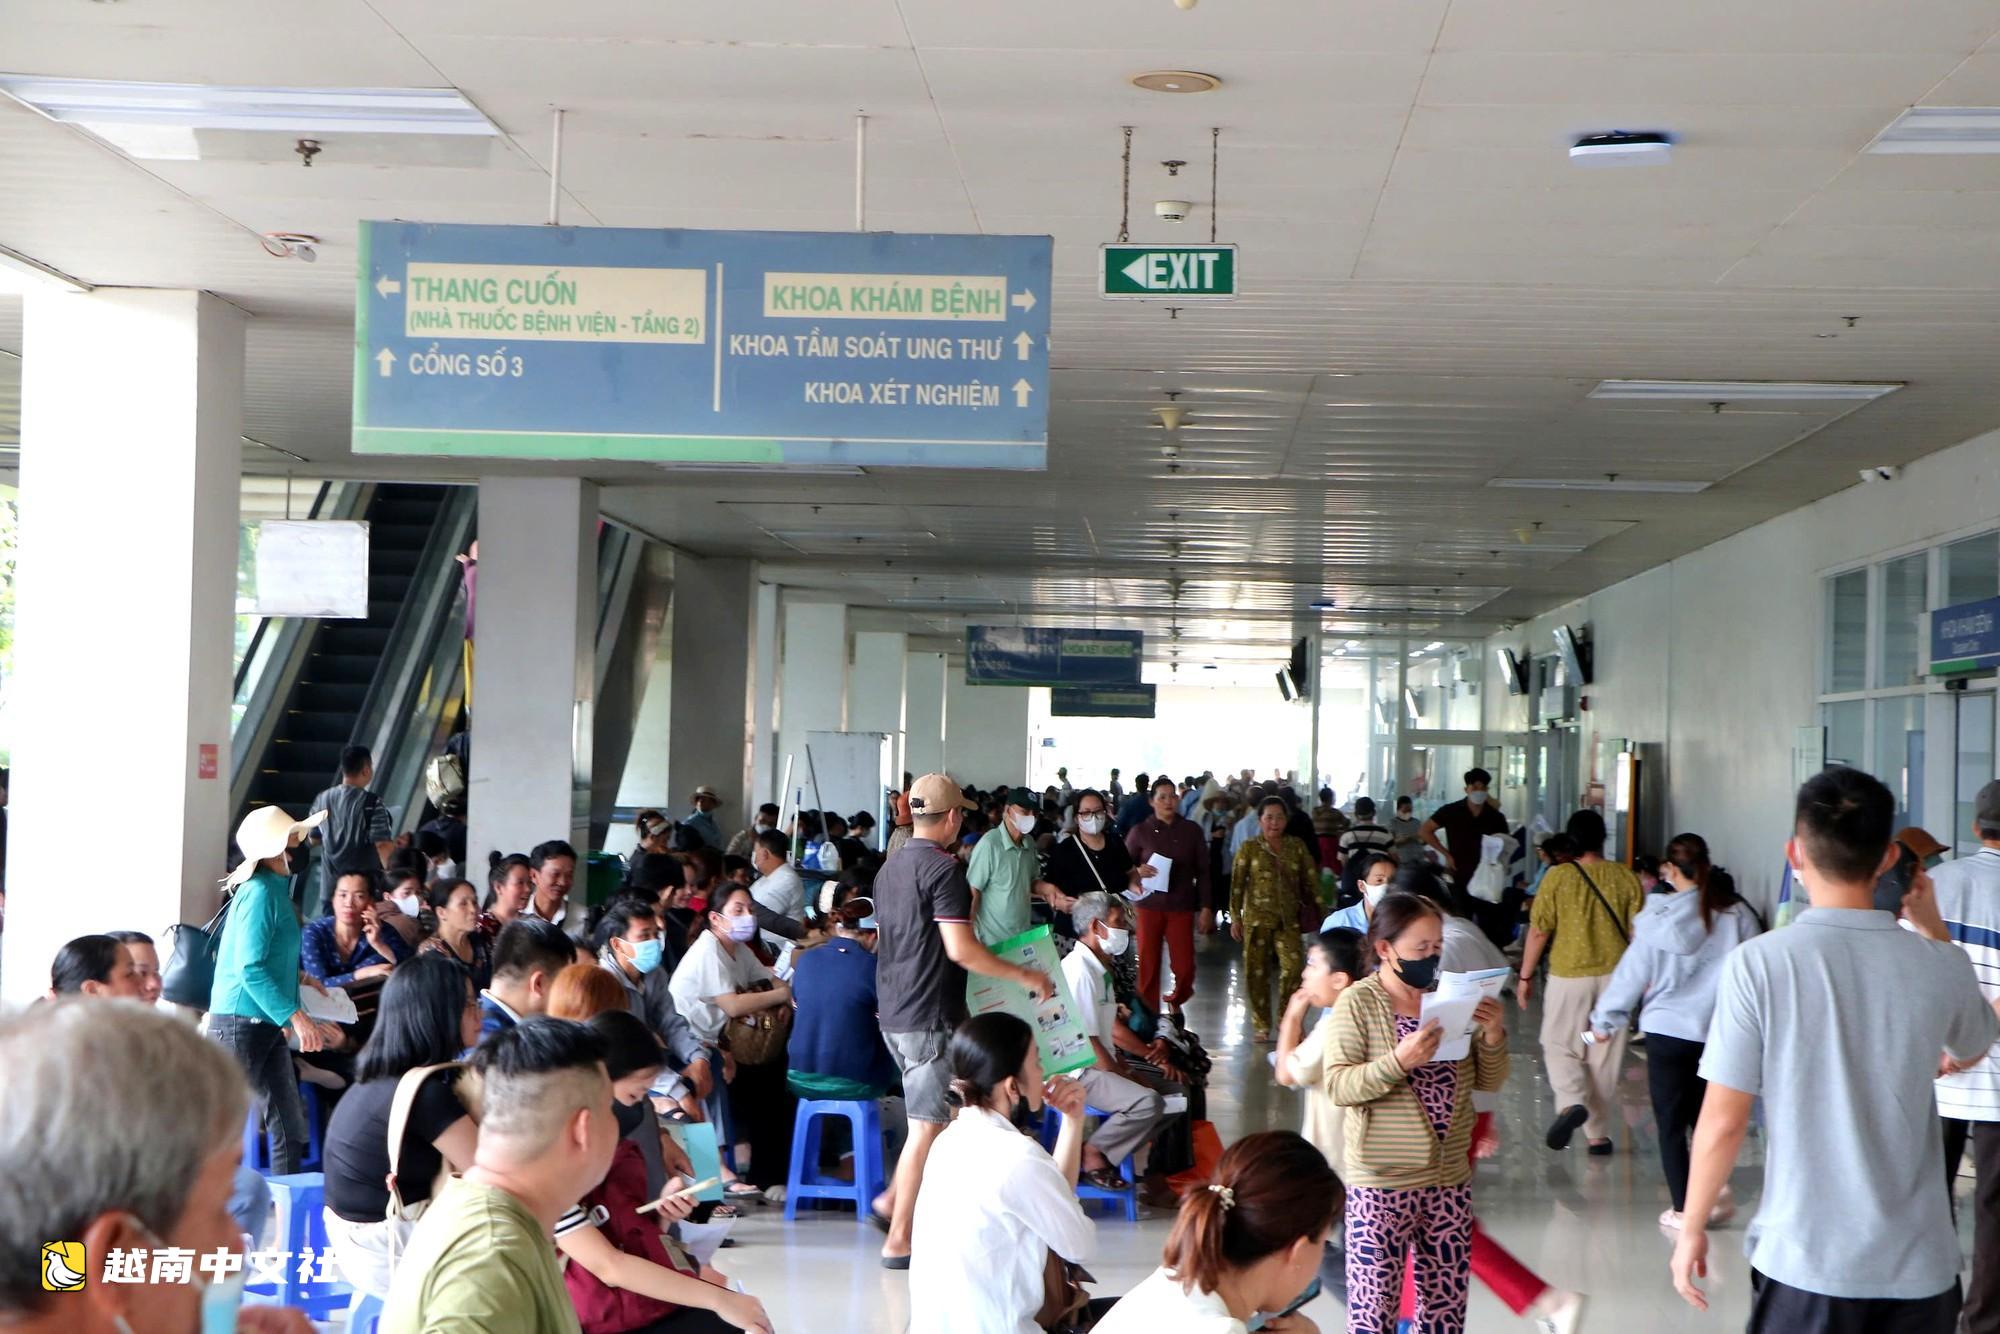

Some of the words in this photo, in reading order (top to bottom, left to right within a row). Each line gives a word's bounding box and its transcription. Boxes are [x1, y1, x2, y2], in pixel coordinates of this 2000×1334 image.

[411, 276, 498, 304] THANG
[506, 270, 577, 306] CUỐN
[1147, 252, 1220, 290] EXIT
[772, 284, 843, 312] KHOA
[850, 281, 923, 313] KHÁM
[931, 282, 1001, 319] BỆNH
[410, 307, 452, 332] (NHÀ
[457, 305, 518, 331] THUỐC
[523, 309, 571, 335] BỆNH
[576, 310, 617, 336] VIỆN
[684, 316, 700, 339] 2)
[409, 341, 471, 377] CỔNG
[476, 346, 507, 377] SỐ
[511, 356, 524, 377] 3
[730, 334, 789, 357] KHOA
[794, 326, 838, 358] TẦM
[845, 331, 901, 359] SOÁT
[907, 338, 952, 360] UNG
[958, 336, 1003, 361] THƯ
[804, 381, 864, 404] KHOA
[869, 377, 911, 406] XÉT
[916, 378, 1000, 411] NGHIỆM
